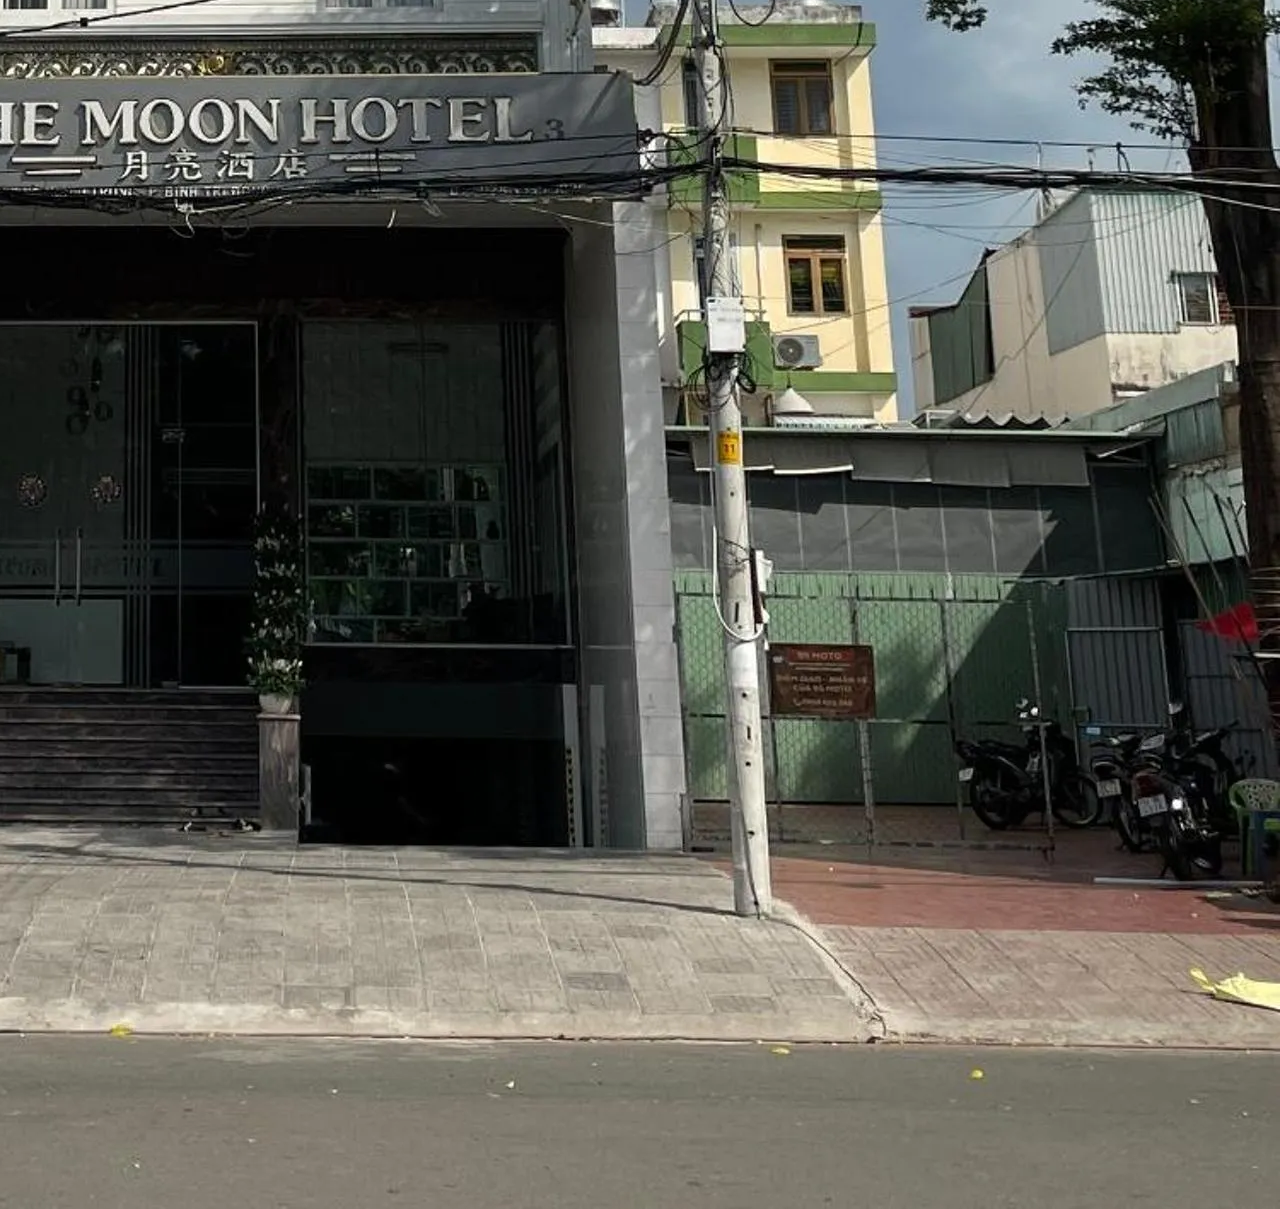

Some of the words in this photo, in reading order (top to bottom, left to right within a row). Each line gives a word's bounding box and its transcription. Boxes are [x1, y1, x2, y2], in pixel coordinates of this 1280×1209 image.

[82, 97, 282, 146] MOON
[300, 96, 534, 143] HOTEL
[121, 149, 308, 182] 月亮酒店
